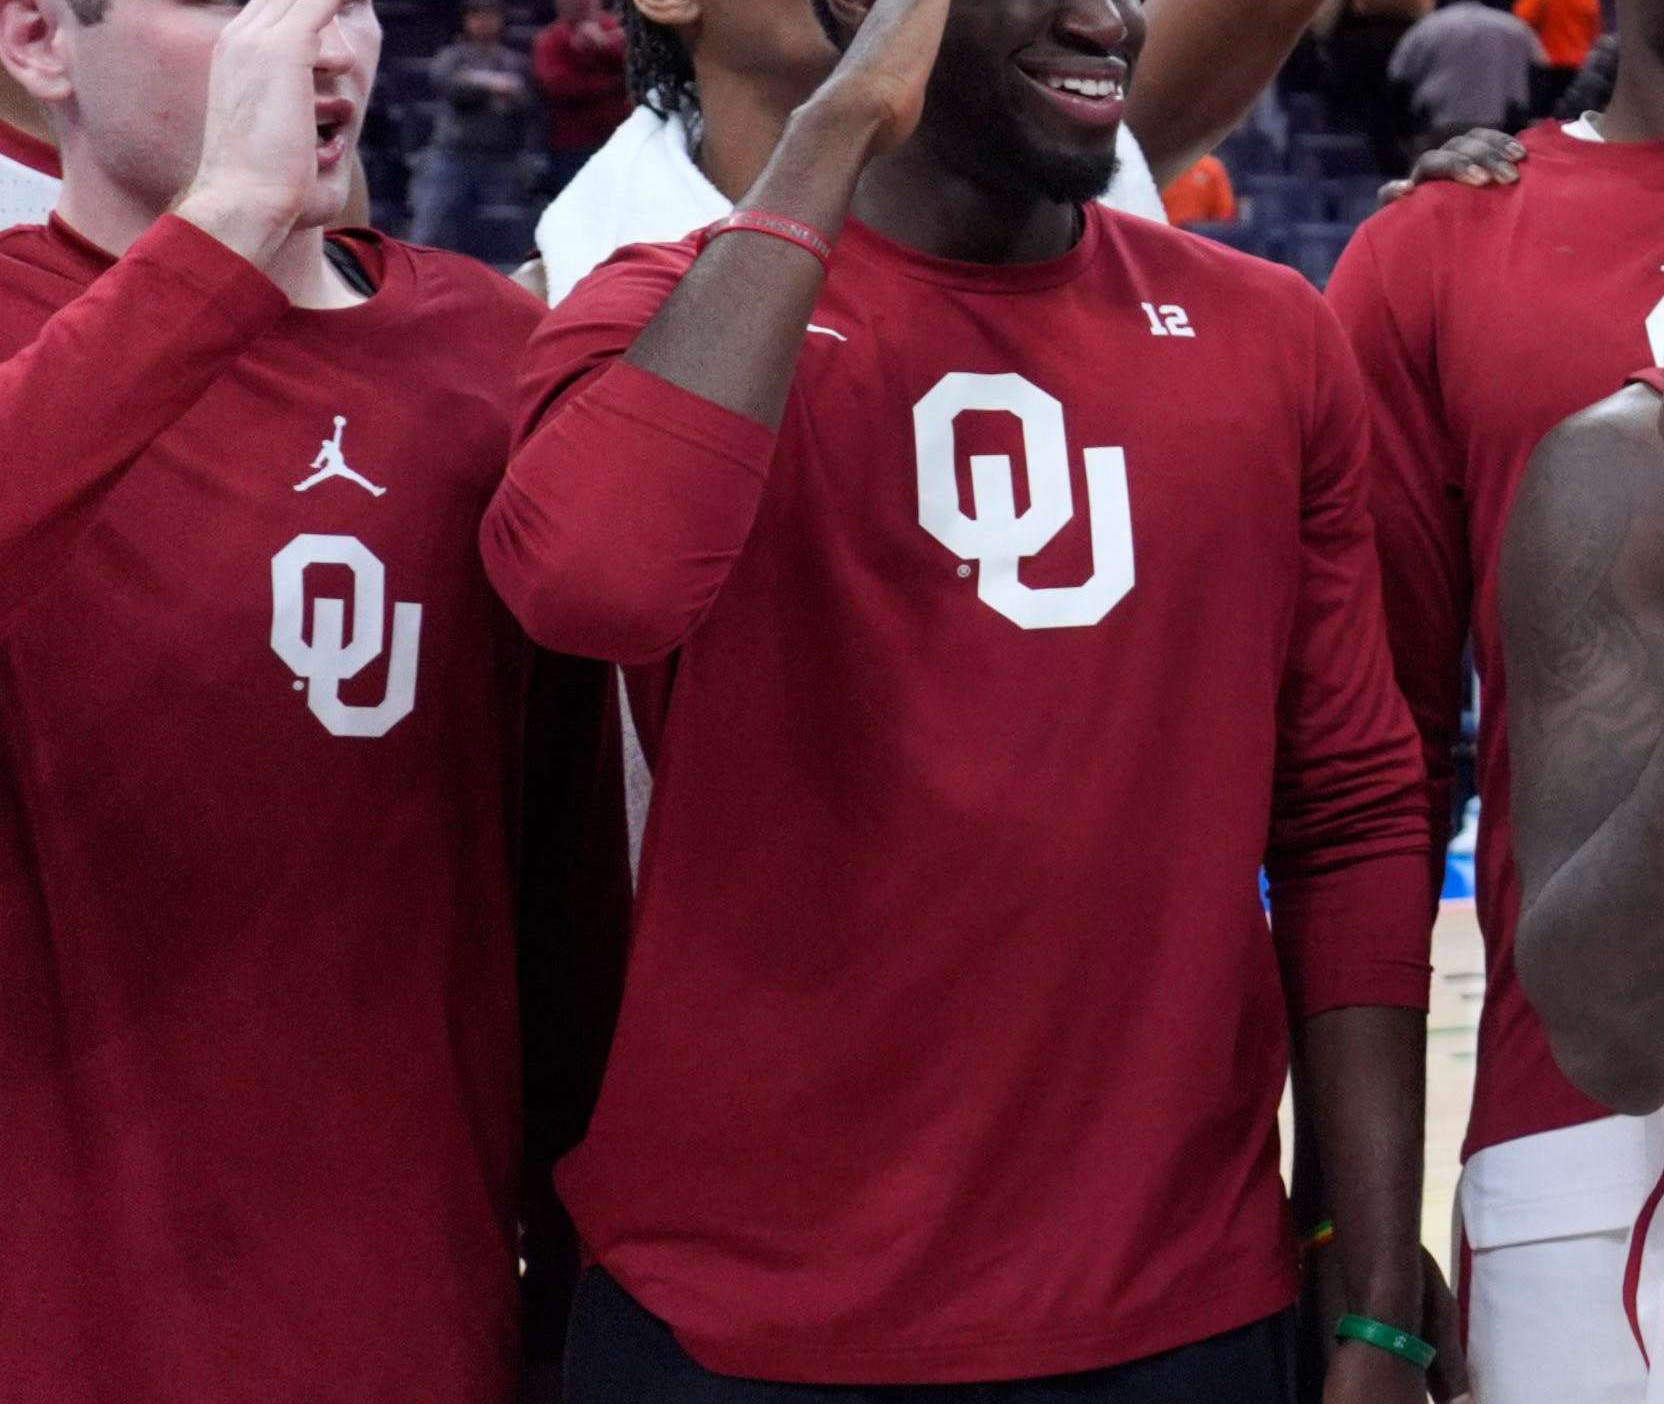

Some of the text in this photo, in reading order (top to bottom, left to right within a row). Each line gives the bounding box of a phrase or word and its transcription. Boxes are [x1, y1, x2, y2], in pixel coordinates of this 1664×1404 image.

[1140, 301, 1196, 338] 12
[913, 372, 1135, 630] OU
[271, 533, 422, 737] OU
